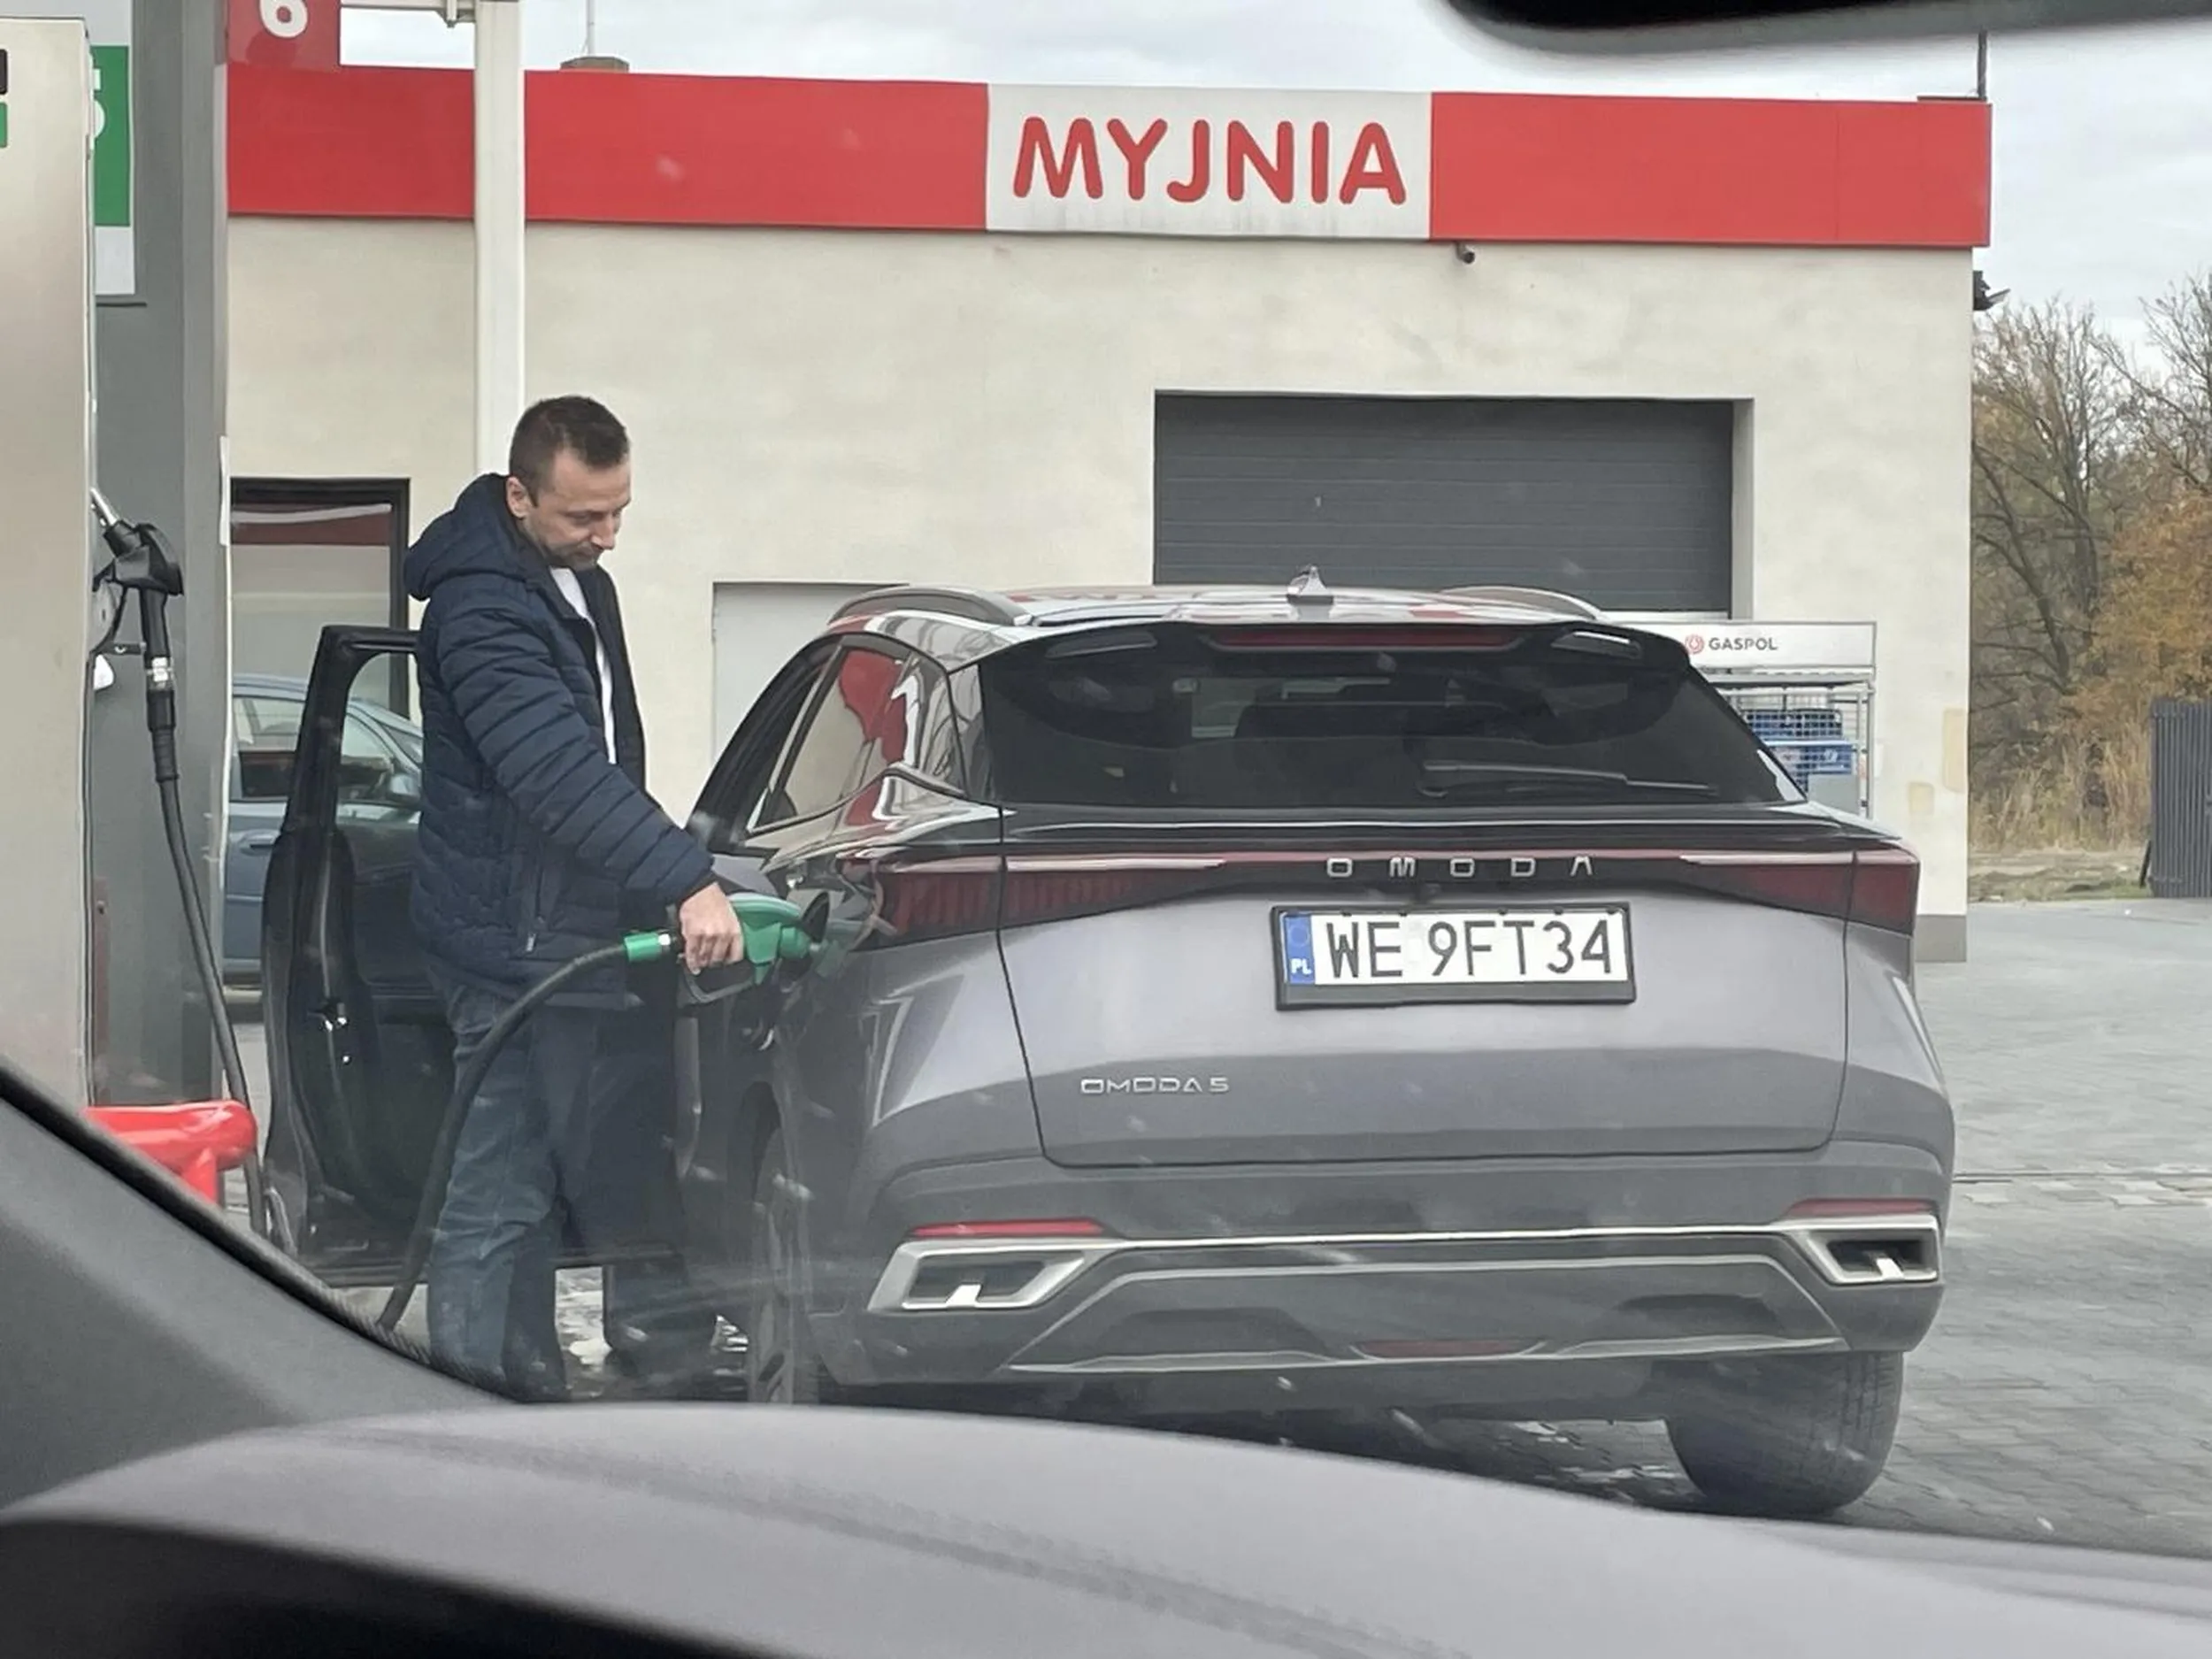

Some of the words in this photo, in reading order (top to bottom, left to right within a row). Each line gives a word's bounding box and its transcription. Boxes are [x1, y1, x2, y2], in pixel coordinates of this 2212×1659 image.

[1012, 116, 1407, 205] MYJNIA
[1708, 637, 1778, 651] GASPOL
[1326, 855, 1594, 878] OMODA
[1326, 921, 1403, 978] WE
[1428, 919, 1612, 976] 9FT34
[1290, 957, 1312, 975] PL
[1080, 1076, 1203, 1094] OMODA
[1209, 1076, 1230, 1094] 5
